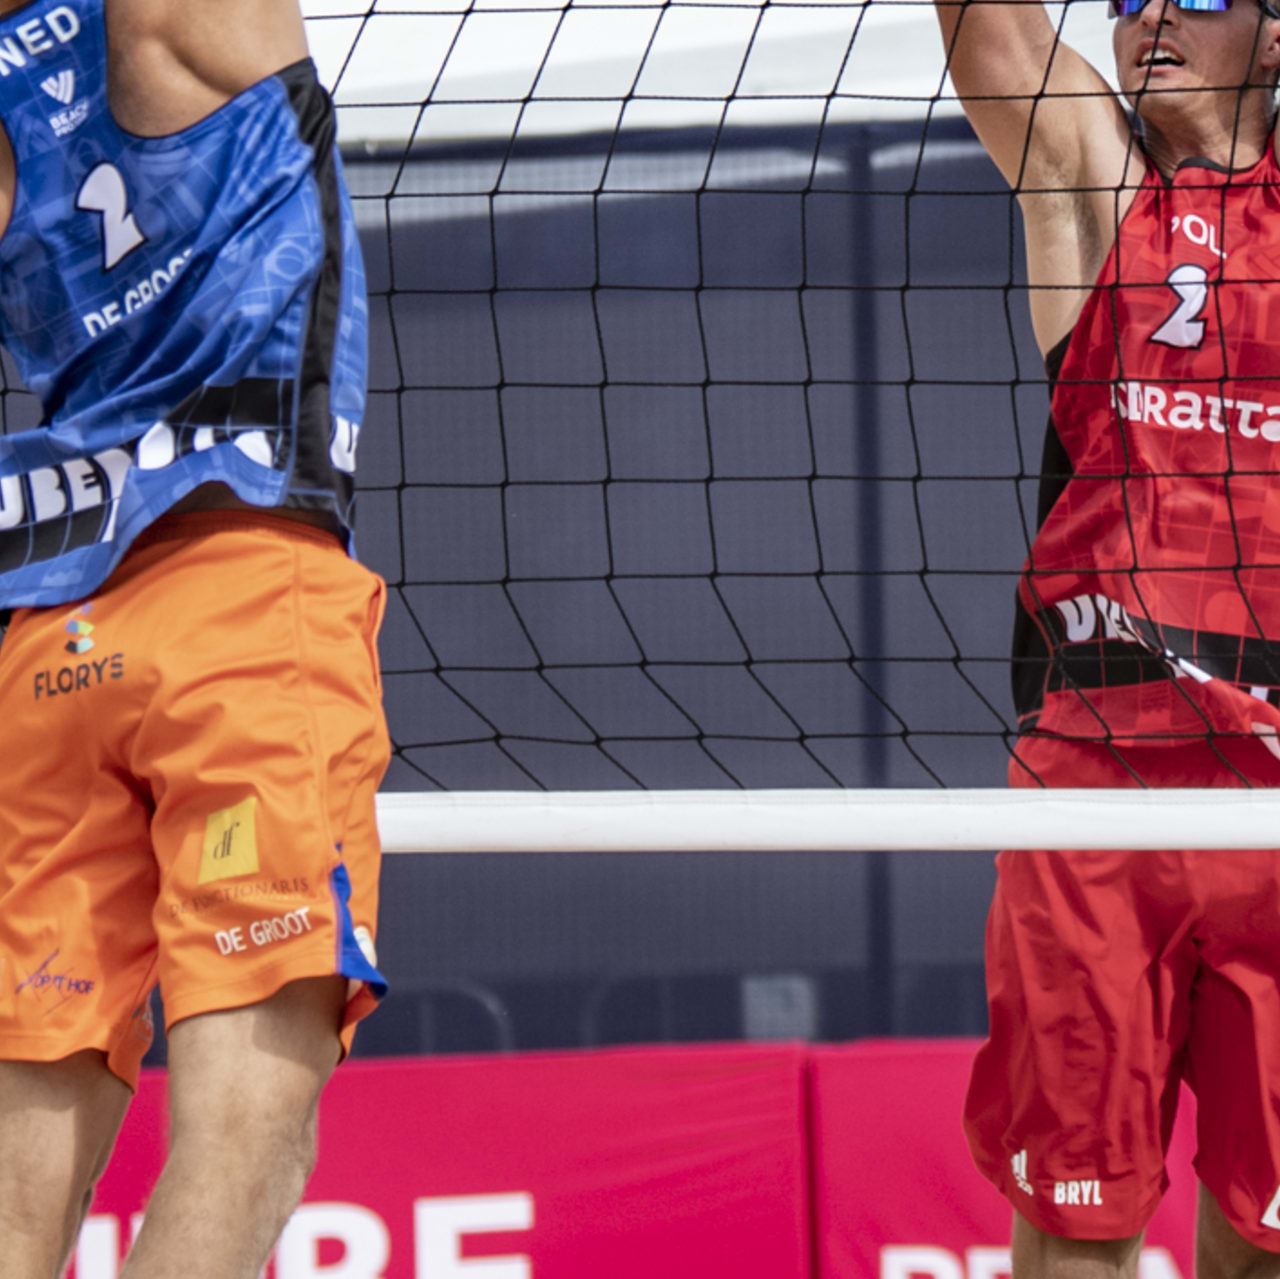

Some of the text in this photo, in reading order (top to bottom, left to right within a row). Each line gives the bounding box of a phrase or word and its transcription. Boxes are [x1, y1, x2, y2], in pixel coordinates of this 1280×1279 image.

[75, 160, 148, 273] 2
[1147, 264, 1208, 350] 2
[214, 906, 312, 956] DE GROOT
[1054, 1180, 1103, 1206] BRYL
